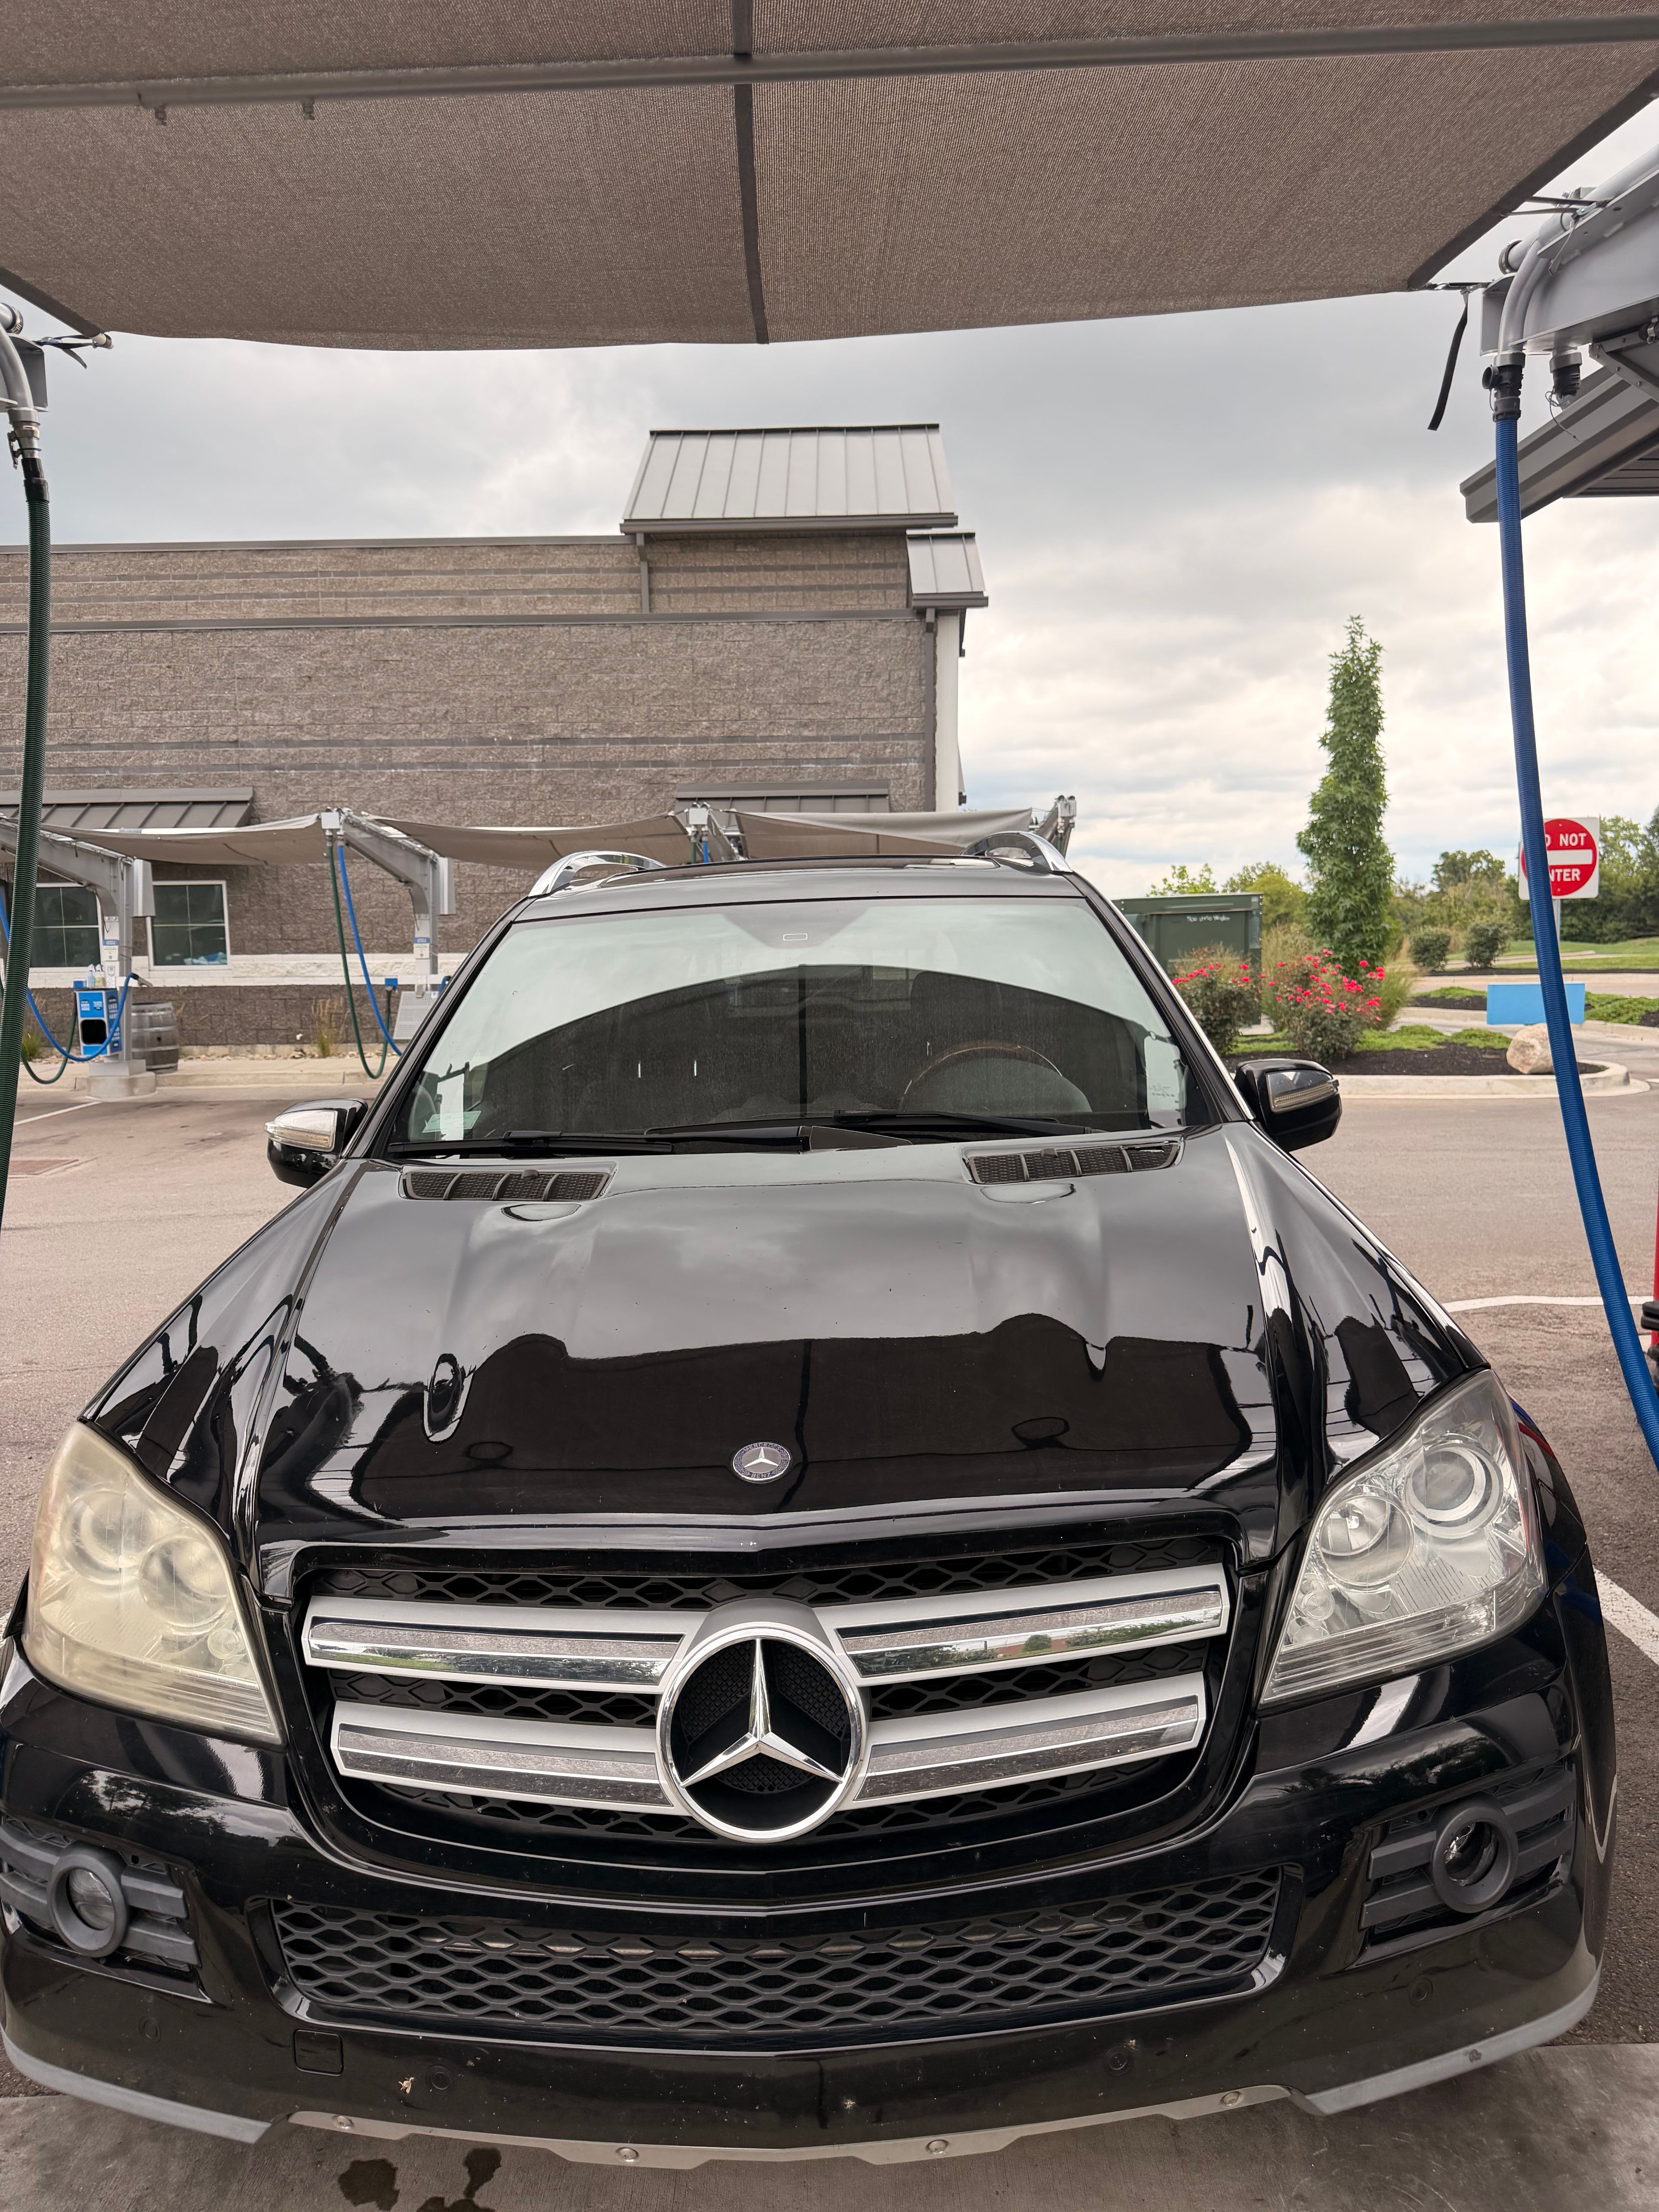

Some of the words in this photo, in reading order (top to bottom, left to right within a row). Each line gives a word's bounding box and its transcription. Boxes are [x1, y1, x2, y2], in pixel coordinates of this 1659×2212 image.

[1544, 833, 1551, 847] O
[1559, 833, 1587, 847] NOT
[1549, 868, 1581, 882] NTER
[744, 1443, 781, 1451] MERCEDES
